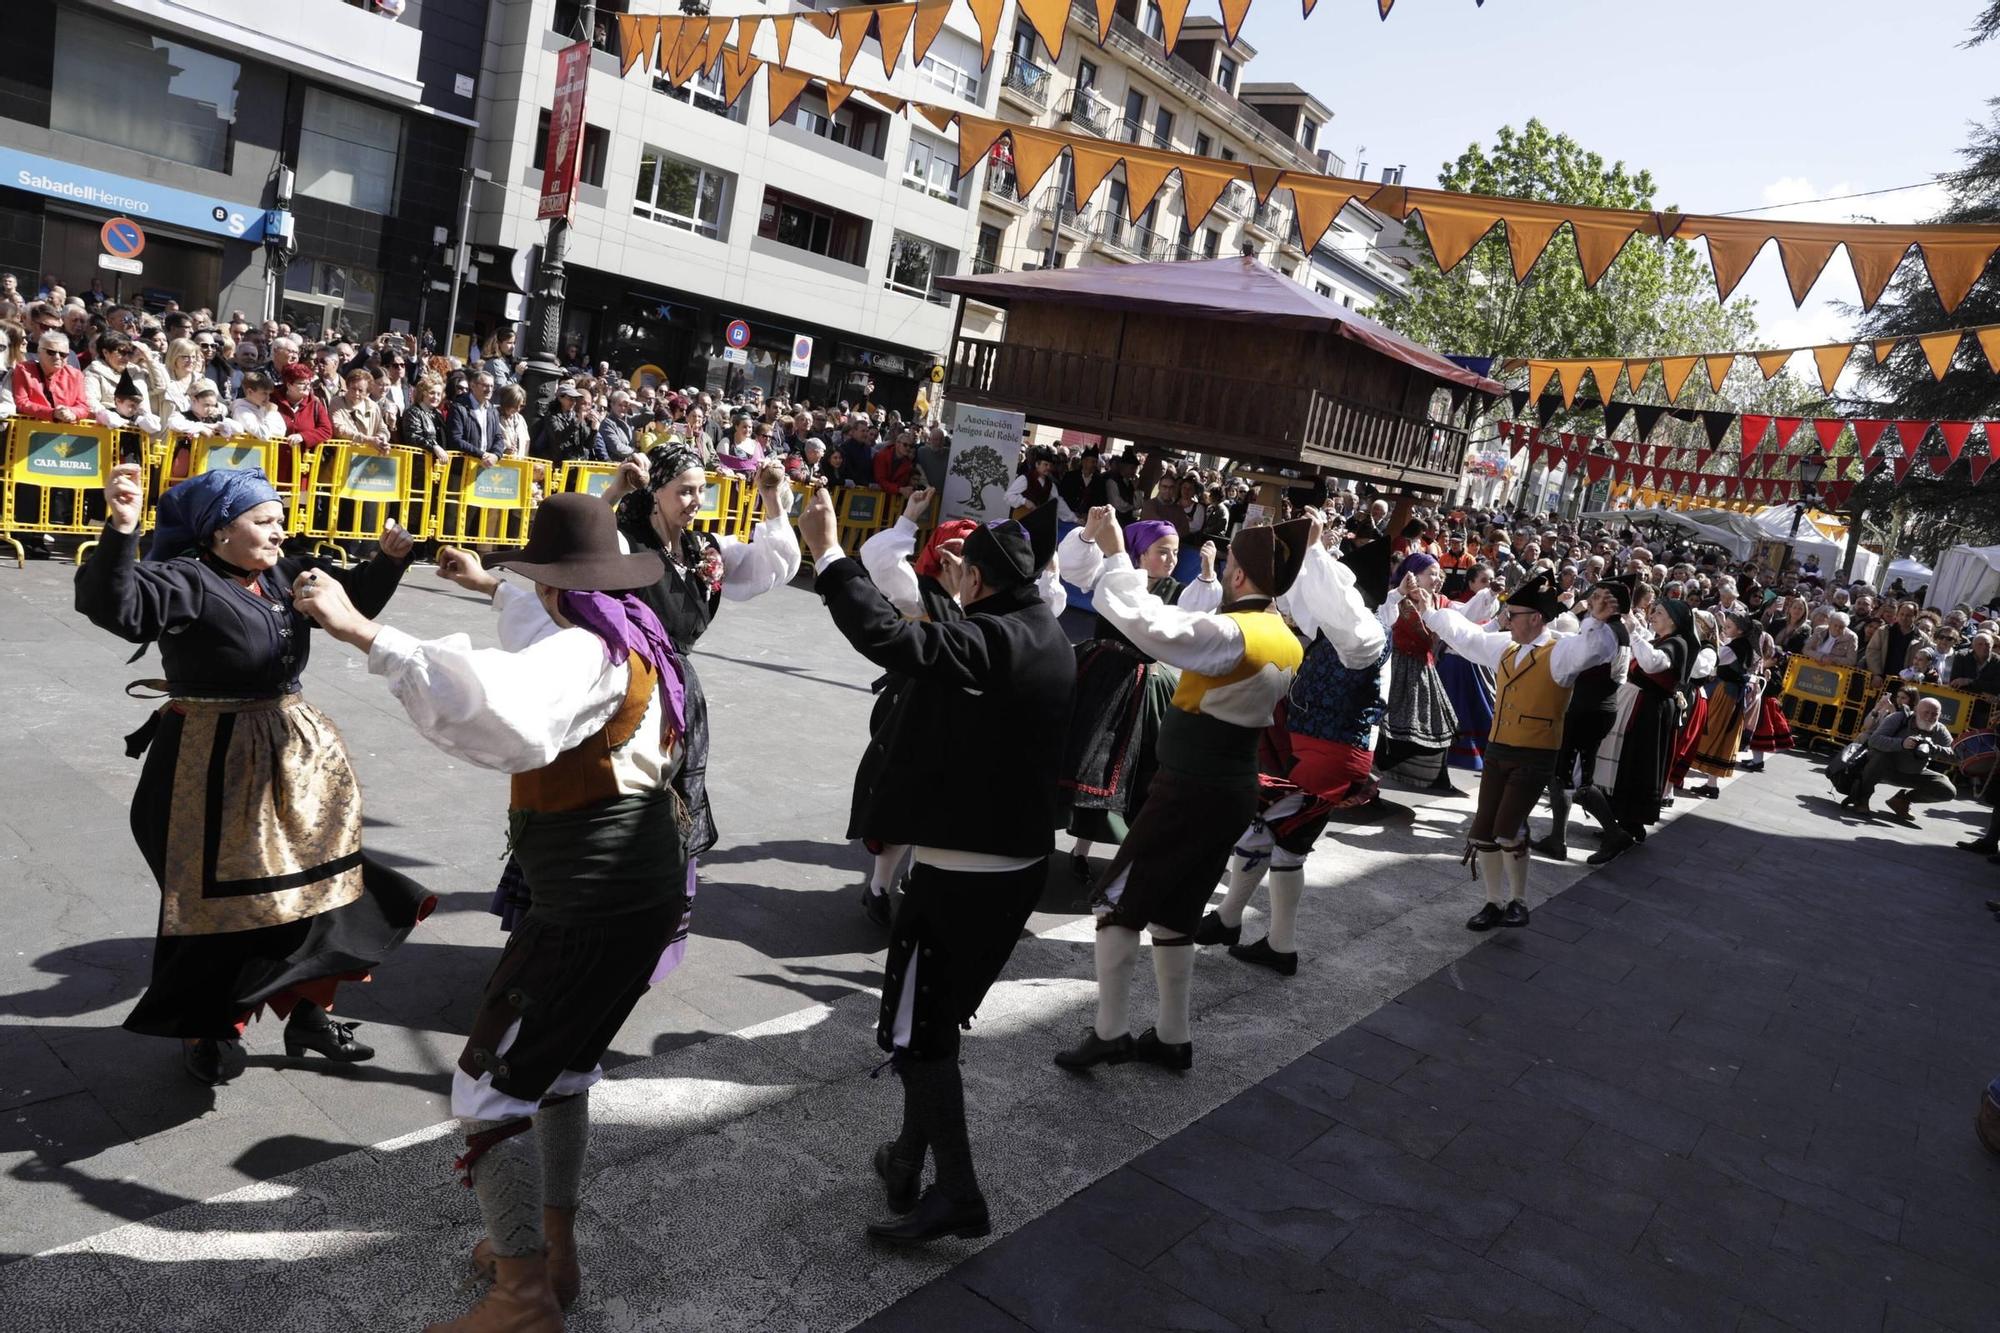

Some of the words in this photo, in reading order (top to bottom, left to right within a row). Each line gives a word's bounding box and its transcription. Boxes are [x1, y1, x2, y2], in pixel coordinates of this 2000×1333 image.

[18, 170, 149, 213] SabadellHerrero
[229, 213, 245, 234] S
[964, 415, 1012, 430] Asociación
[956, 424, 982, 437] Amigos
[984, 429, 996, 439] del
[997, 432, 1019, 443] Roble
[34, 459, 58, 467] CAJA
[59, 460, 92, 470] RURAL
